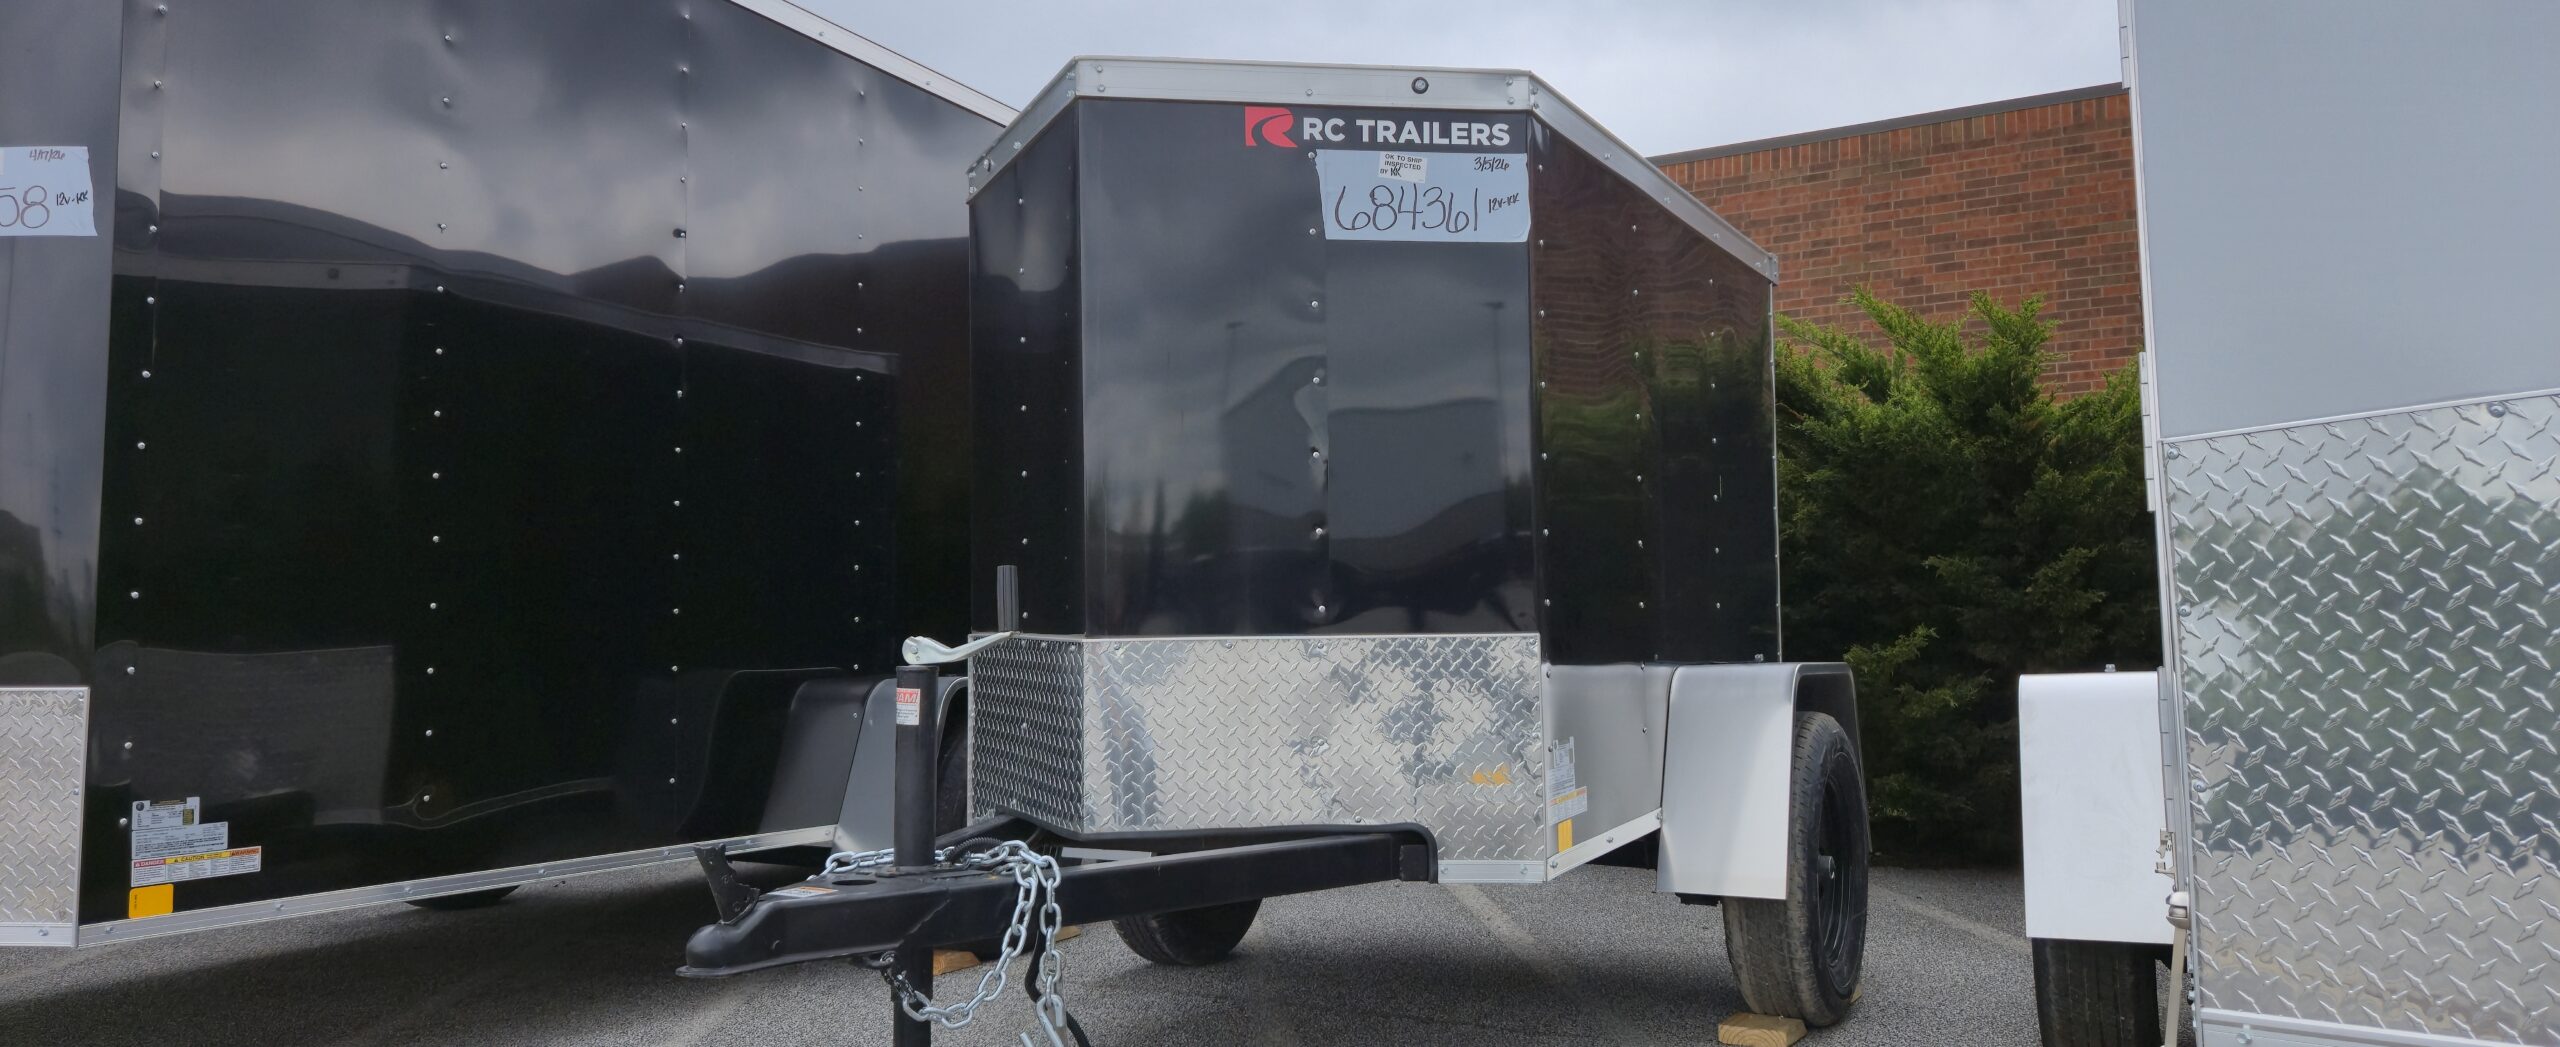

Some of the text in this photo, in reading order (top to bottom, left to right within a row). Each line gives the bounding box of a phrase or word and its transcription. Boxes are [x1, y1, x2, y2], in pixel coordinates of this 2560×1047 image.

[1303, 117, 1345, 141] RC
[1356, 119, 1510, 146] TRAILERS
[1384, 160, 1421, 170] INSPECTED
[1407, 156, 1423, 164] SHIP
[1473, 156, 1510, 172] 3/5/26
[1334, 182, 1480, 234] 684361
